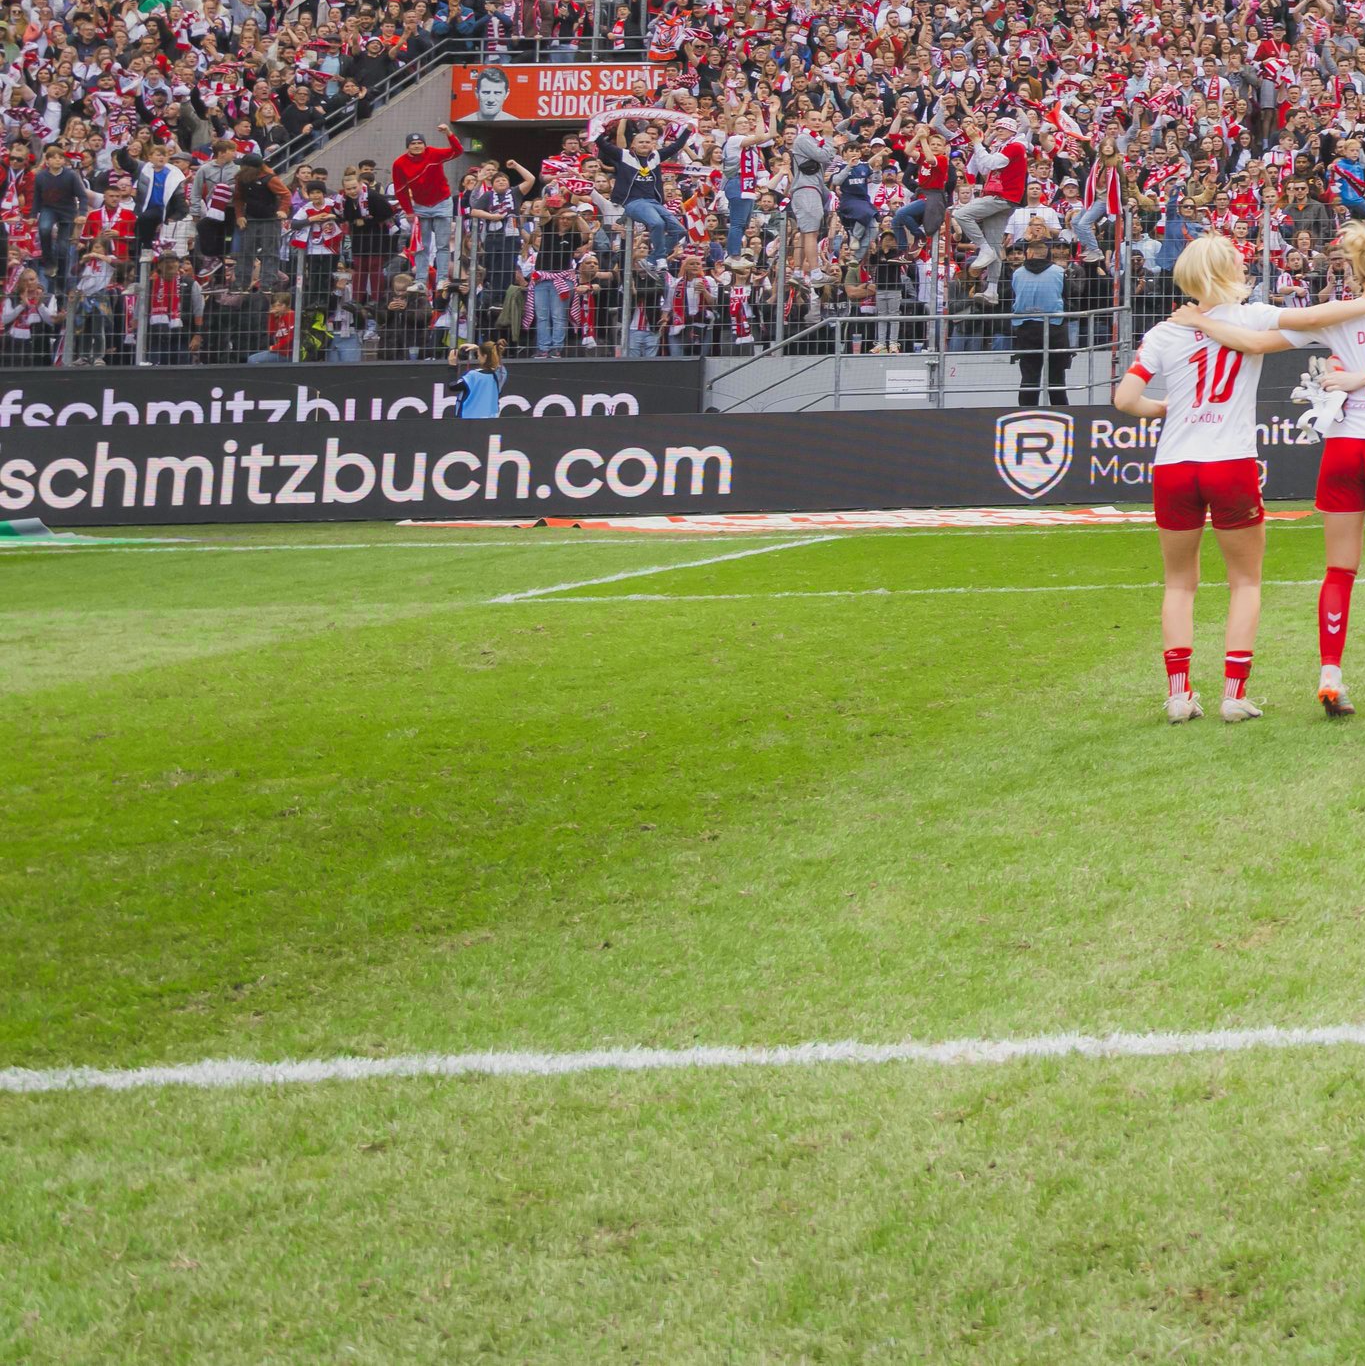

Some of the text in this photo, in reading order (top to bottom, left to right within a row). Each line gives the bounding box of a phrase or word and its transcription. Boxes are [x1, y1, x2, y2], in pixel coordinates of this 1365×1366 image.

[538, 69, 592, 91] HANS
[1188, 346, 1244, 409] 10
[1090, 418, 1161, 450] Ralf
